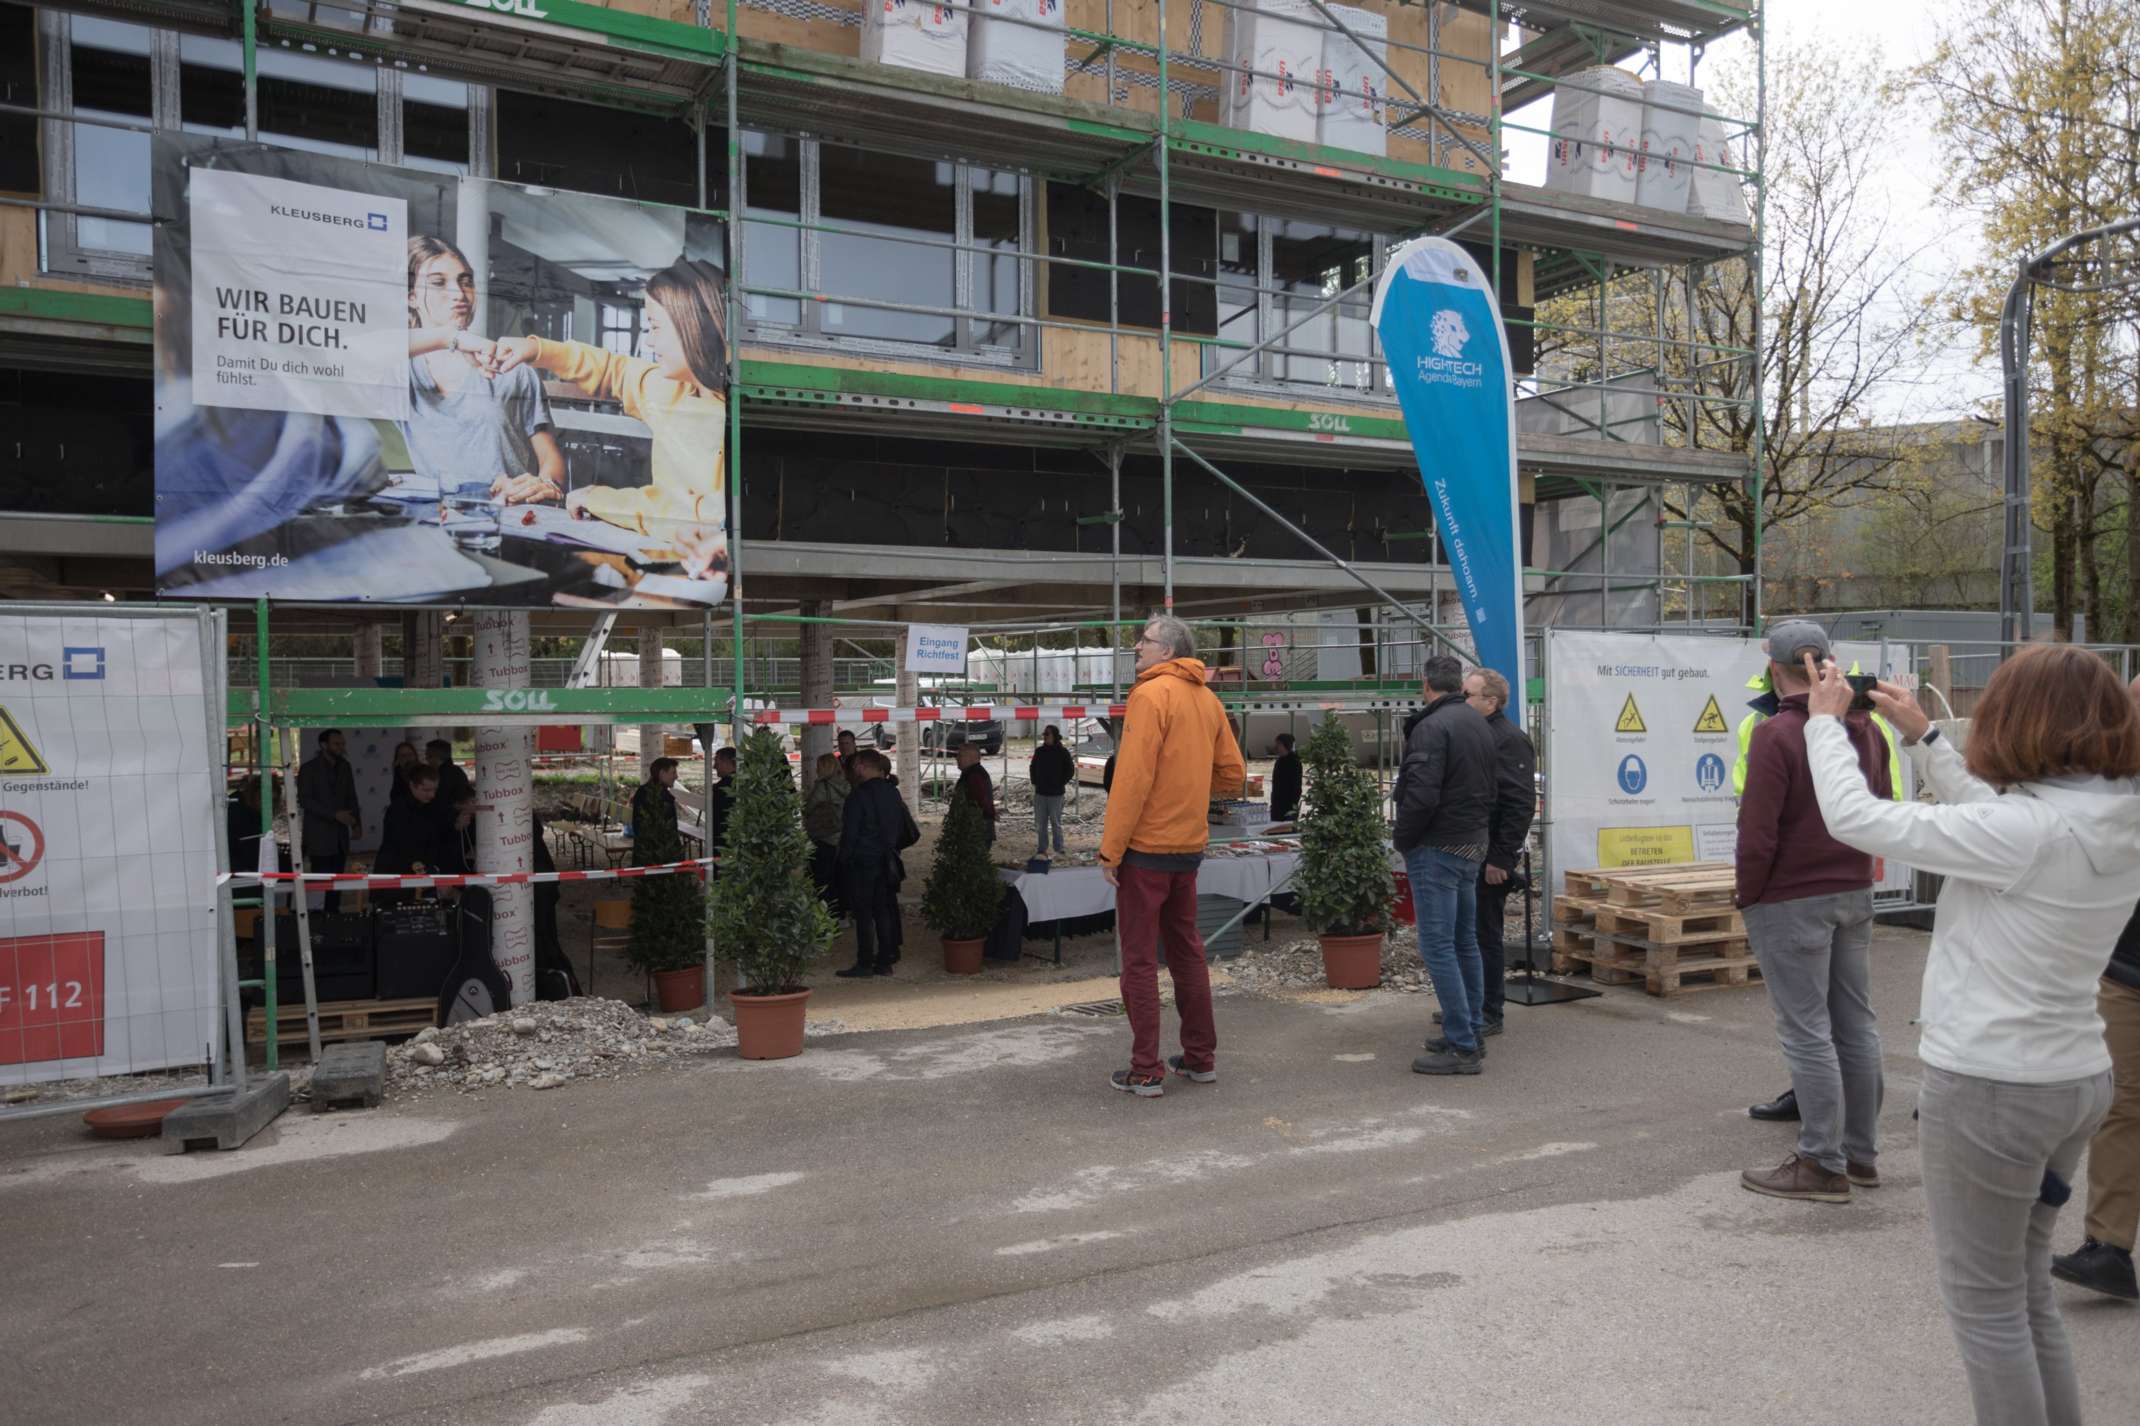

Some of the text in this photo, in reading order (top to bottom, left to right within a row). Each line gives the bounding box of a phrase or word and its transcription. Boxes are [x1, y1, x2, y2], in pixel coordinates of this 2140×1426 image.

[270, 204, 365, 229] KLEUSBERG
[216, 286, 366, 325] WIR BAUEN
[218, 312, 348, 351] FÜR DICH.
[216, 355, 345, 378] Damit Du dich wohl
[216, 370, 257, 387] fühlst.
[1434, 477, 1461, 536] Zukunft
[194, 549, 289, 569] kleusberg.de
[919, 635, 960, 650] Eingang
[916, 648, 961, 661] Richtfest
[1597, 664, 1711, 681] Mit SICHERHEIT gut gebaut.
[3, 779, 89, 794] Gegenstände!
[482, 785, 526, 801] Tubbox
[500, 832, 533, 847] Tubbo
[25, 980, 83, 1011] 112
